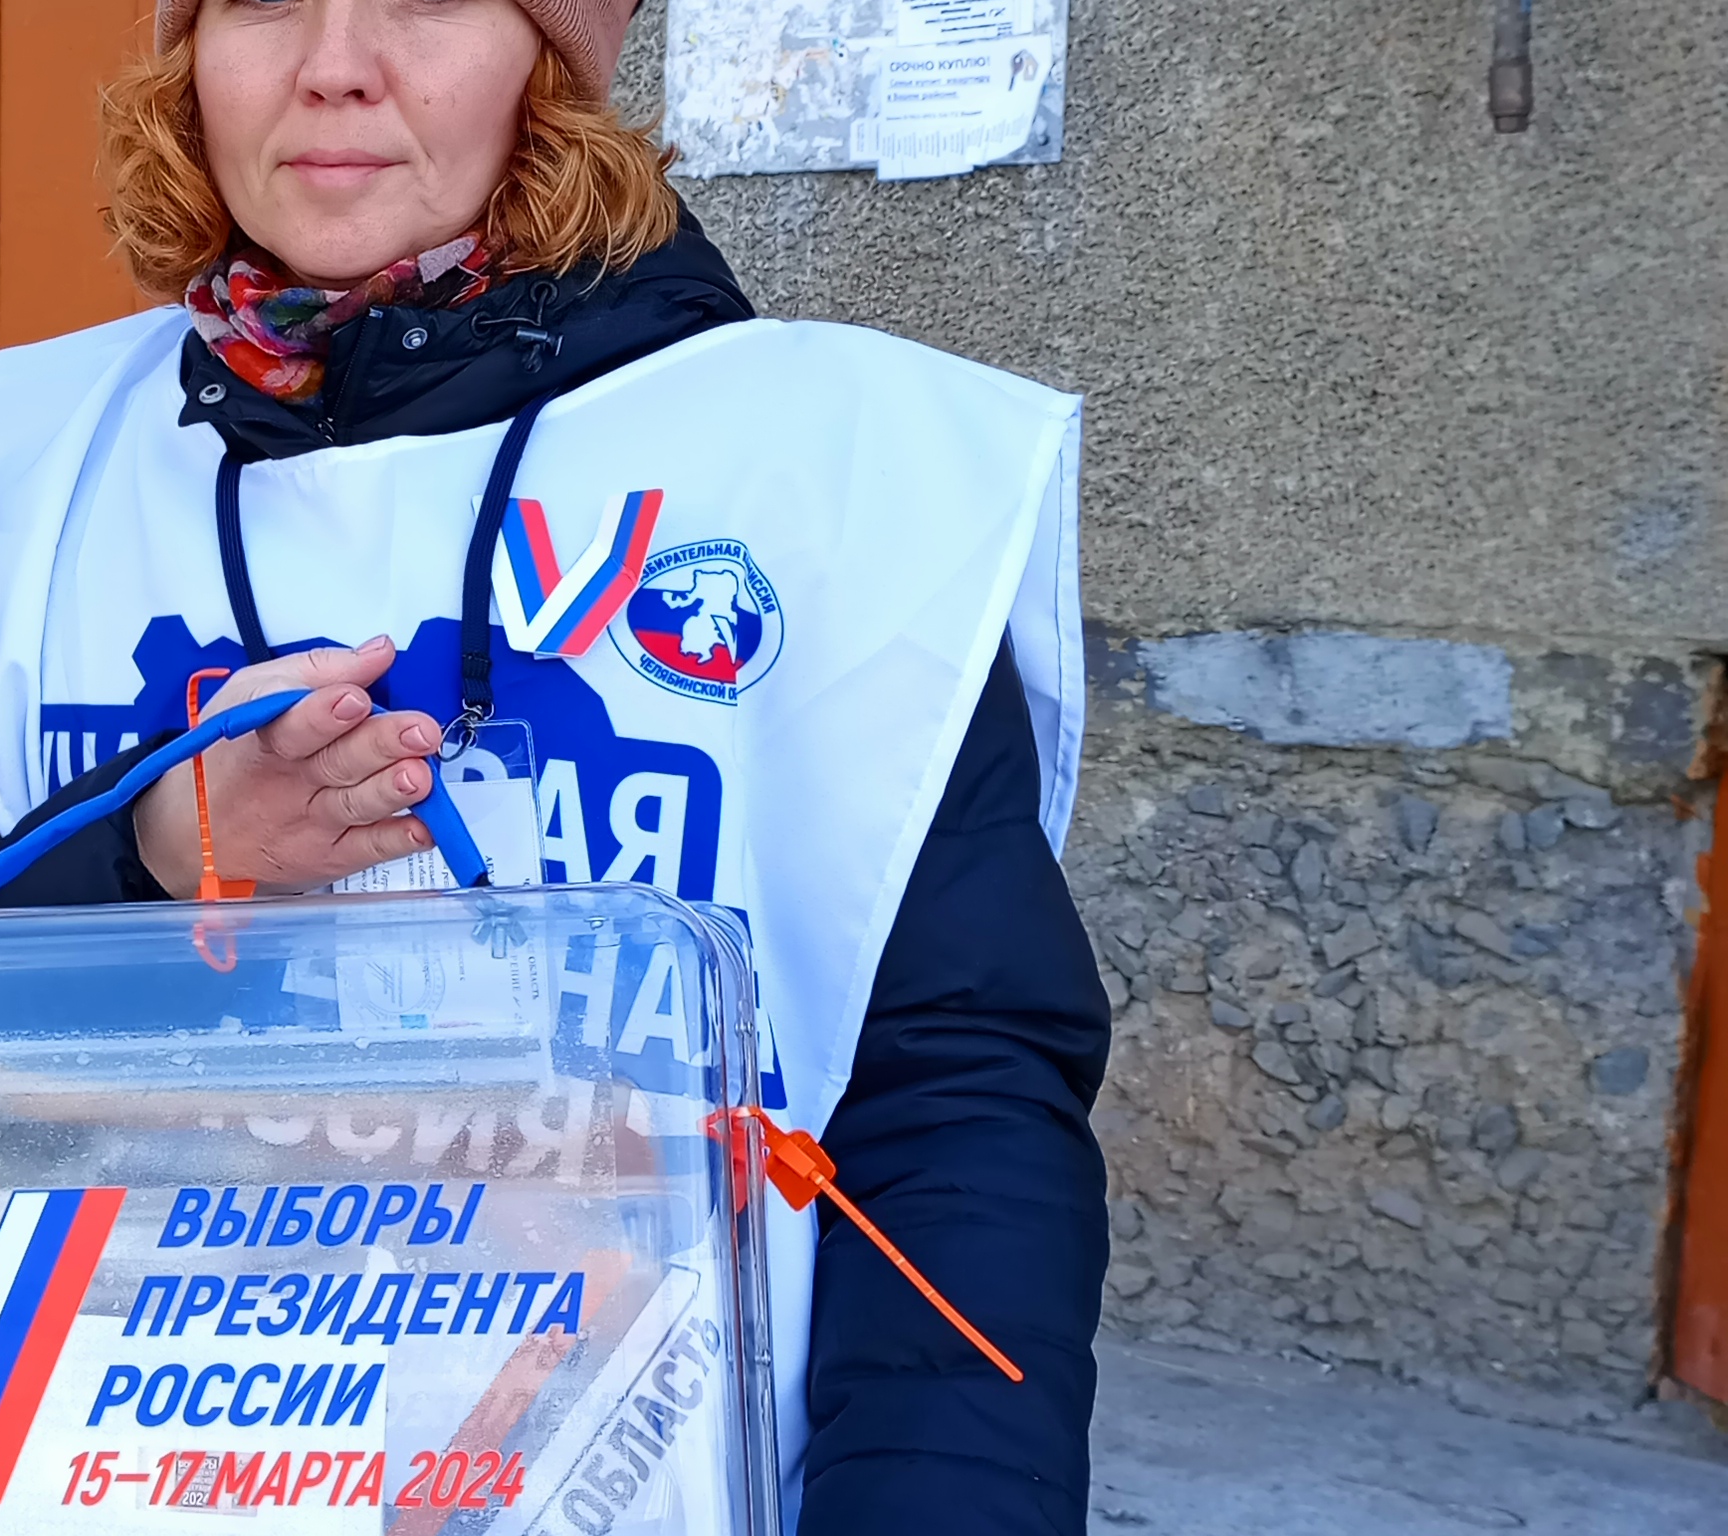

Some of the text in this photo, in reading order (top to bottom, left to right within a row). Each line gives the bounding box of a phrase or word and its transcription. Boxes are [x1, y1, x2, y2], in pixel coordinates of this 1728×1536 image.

[890, 56, 991, 72] СРОЧНО КУПЛЮ!
[640, 543, 741, 584] ЗБИРАТЕЛЬНАЯ
[158, 1182, 486, 1249] ВЫБОРЫ
[122, 1272, 585, 1346] ПРЕЗИДЕНТА
[86, 1363, 385, 1427] РОССИИ
[207, 1451, 387, 1506] МАРТА
[395, 1450, 527, 1508] 2024
